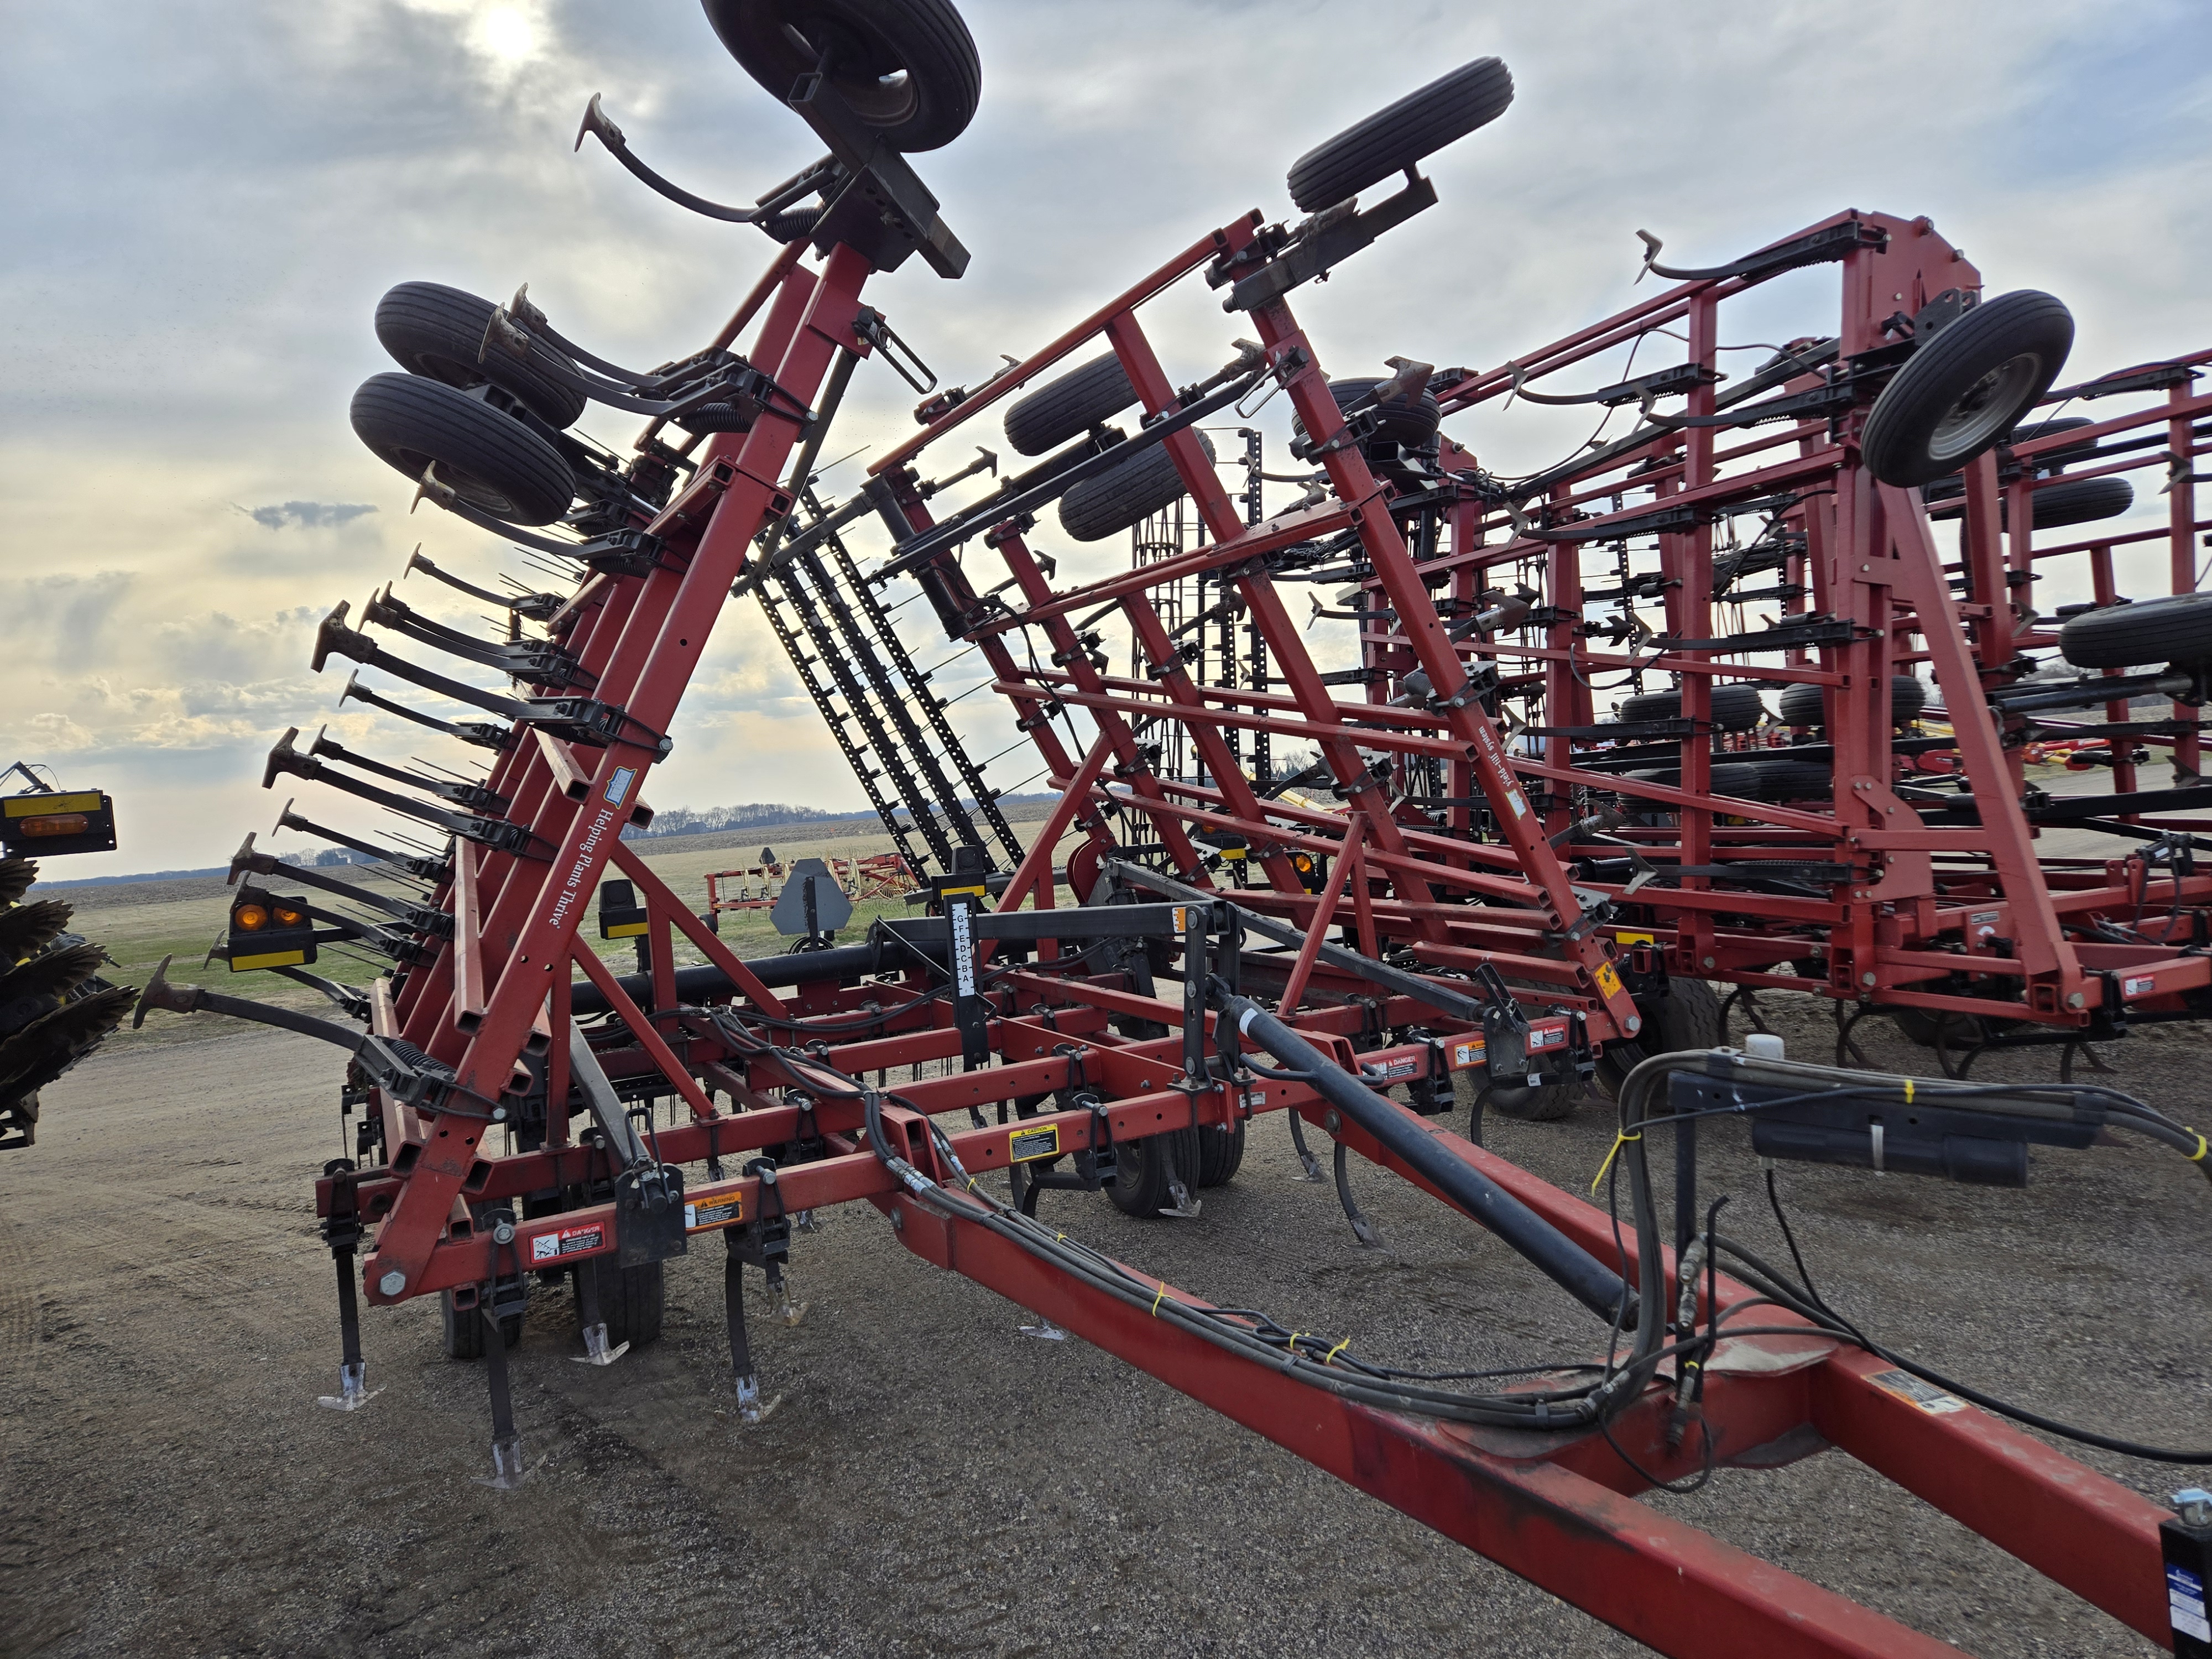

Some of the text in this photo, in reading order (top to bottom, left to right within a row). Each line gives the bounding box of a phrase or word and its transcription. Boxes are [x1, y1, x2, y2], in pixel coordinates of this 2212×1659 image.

[1479, 726, 1495, 752] system
[579, 808, 614, 853] Helping
[566, 853, 593, 888] Plants
[1393, 1055, 1416, 1066] DANGER
[1027, 1126, 1047, 1134] CAUTION
[708, 1196, 735, 1205] WARNING
[572, 1225, 600, 1237] DANGER
